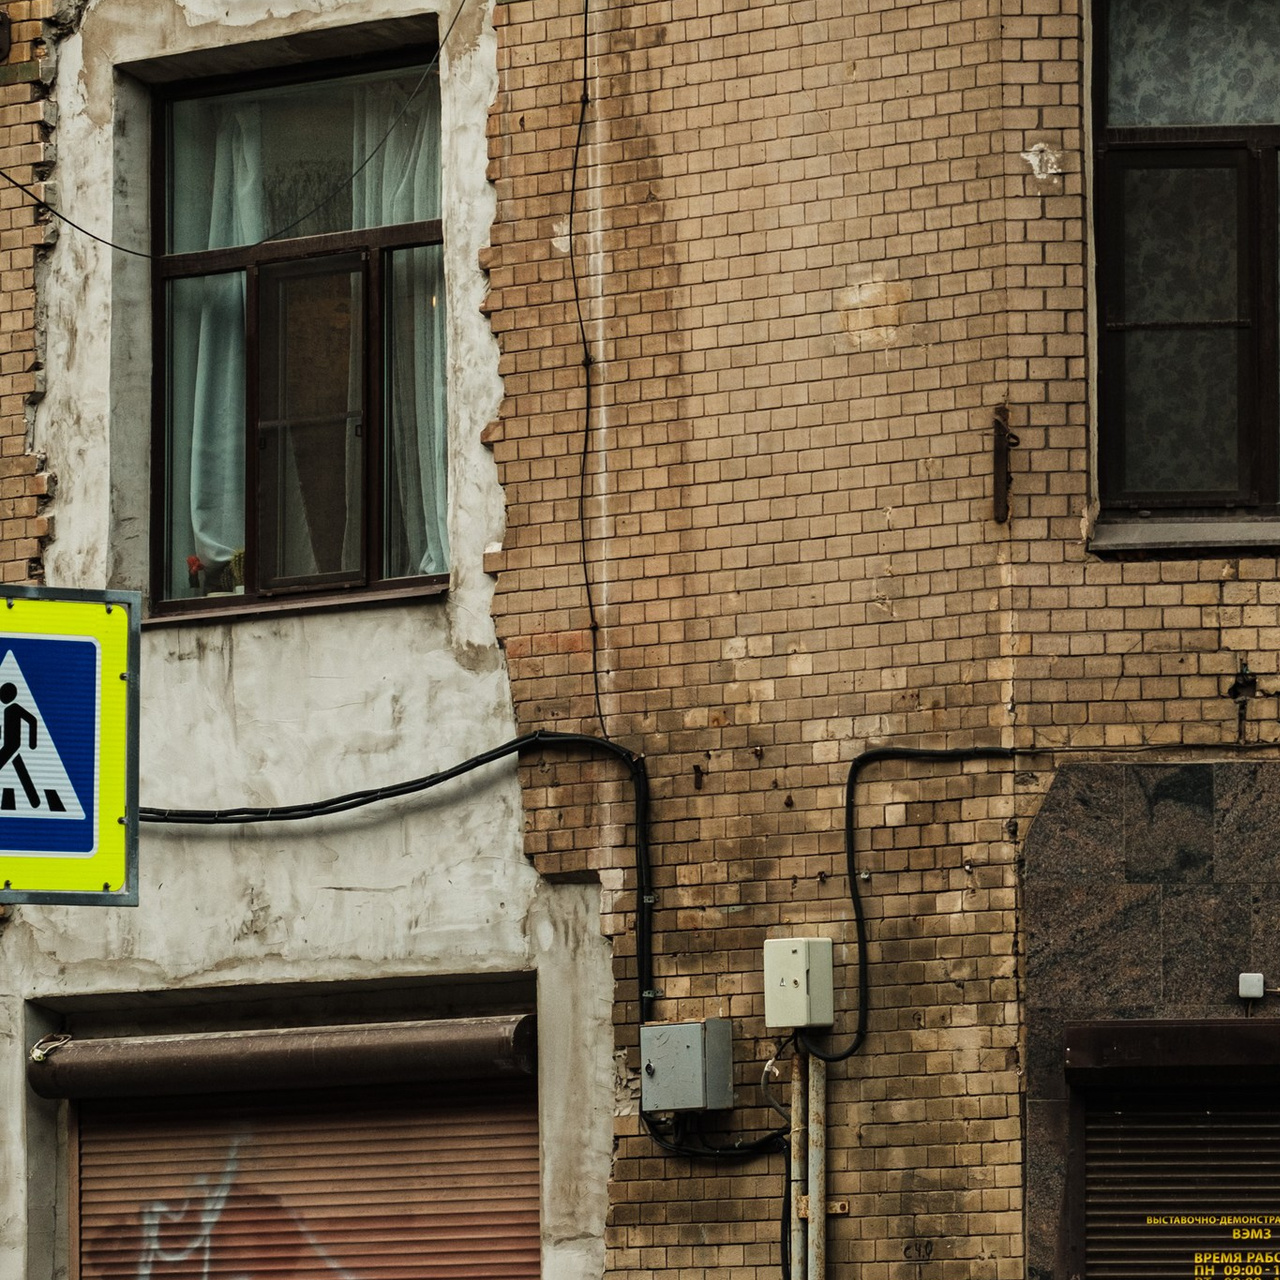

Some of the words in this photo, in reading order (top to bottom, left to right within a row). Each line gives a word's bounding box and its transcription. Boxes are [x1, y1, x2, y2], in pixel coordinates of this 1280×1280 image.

[1232, 1228, 1272, 1240] ВЭМЗ
[1194, 1252, 1242, 1264] ВРЕМЯ
[1194, 1265, 1215, 1275] ПН
[1224, 1265, 1262, 1275] 09:00
